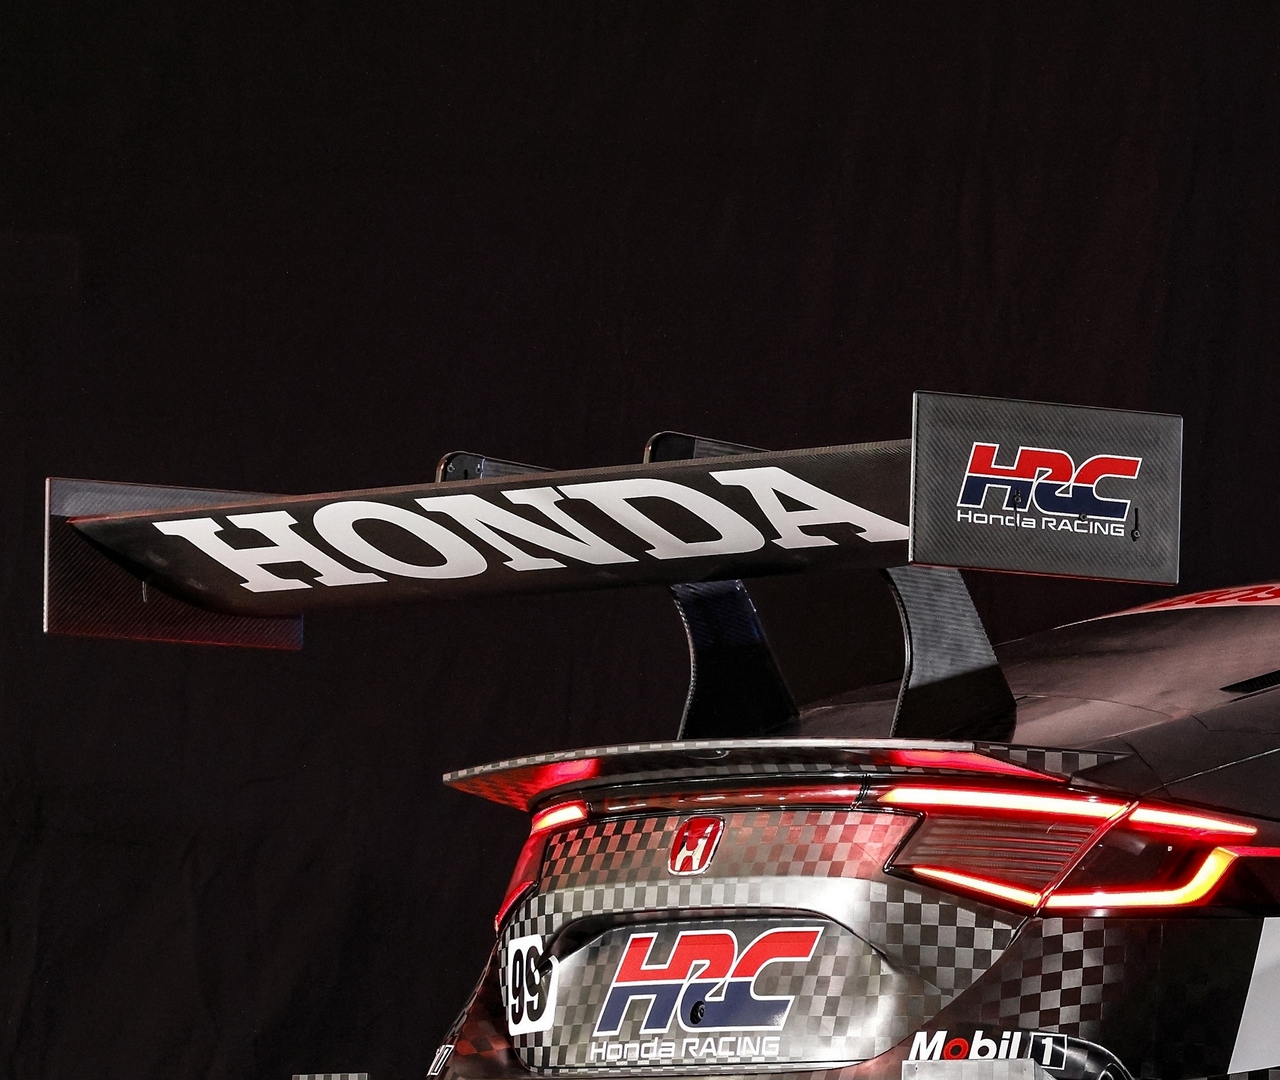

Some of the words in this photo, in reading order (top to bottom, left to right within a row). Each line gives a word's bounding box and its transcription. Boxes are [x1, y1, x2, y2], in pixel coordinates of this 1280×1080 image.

[956, 441, 1143, 521] HRC
[152, 466, 910, 593] HONDA
[956, 509, 1037, 530] Honda
[1041, 517, 1126, 537] RACING
[511, 945, 551, 1025] 99
[592, 927, 825, 1037] HRC
[590, 1039, 675, 1061] Honda
[685, 1036, 780, 1058] RACING
[908, 1031, 1021, 1061] Mobil
